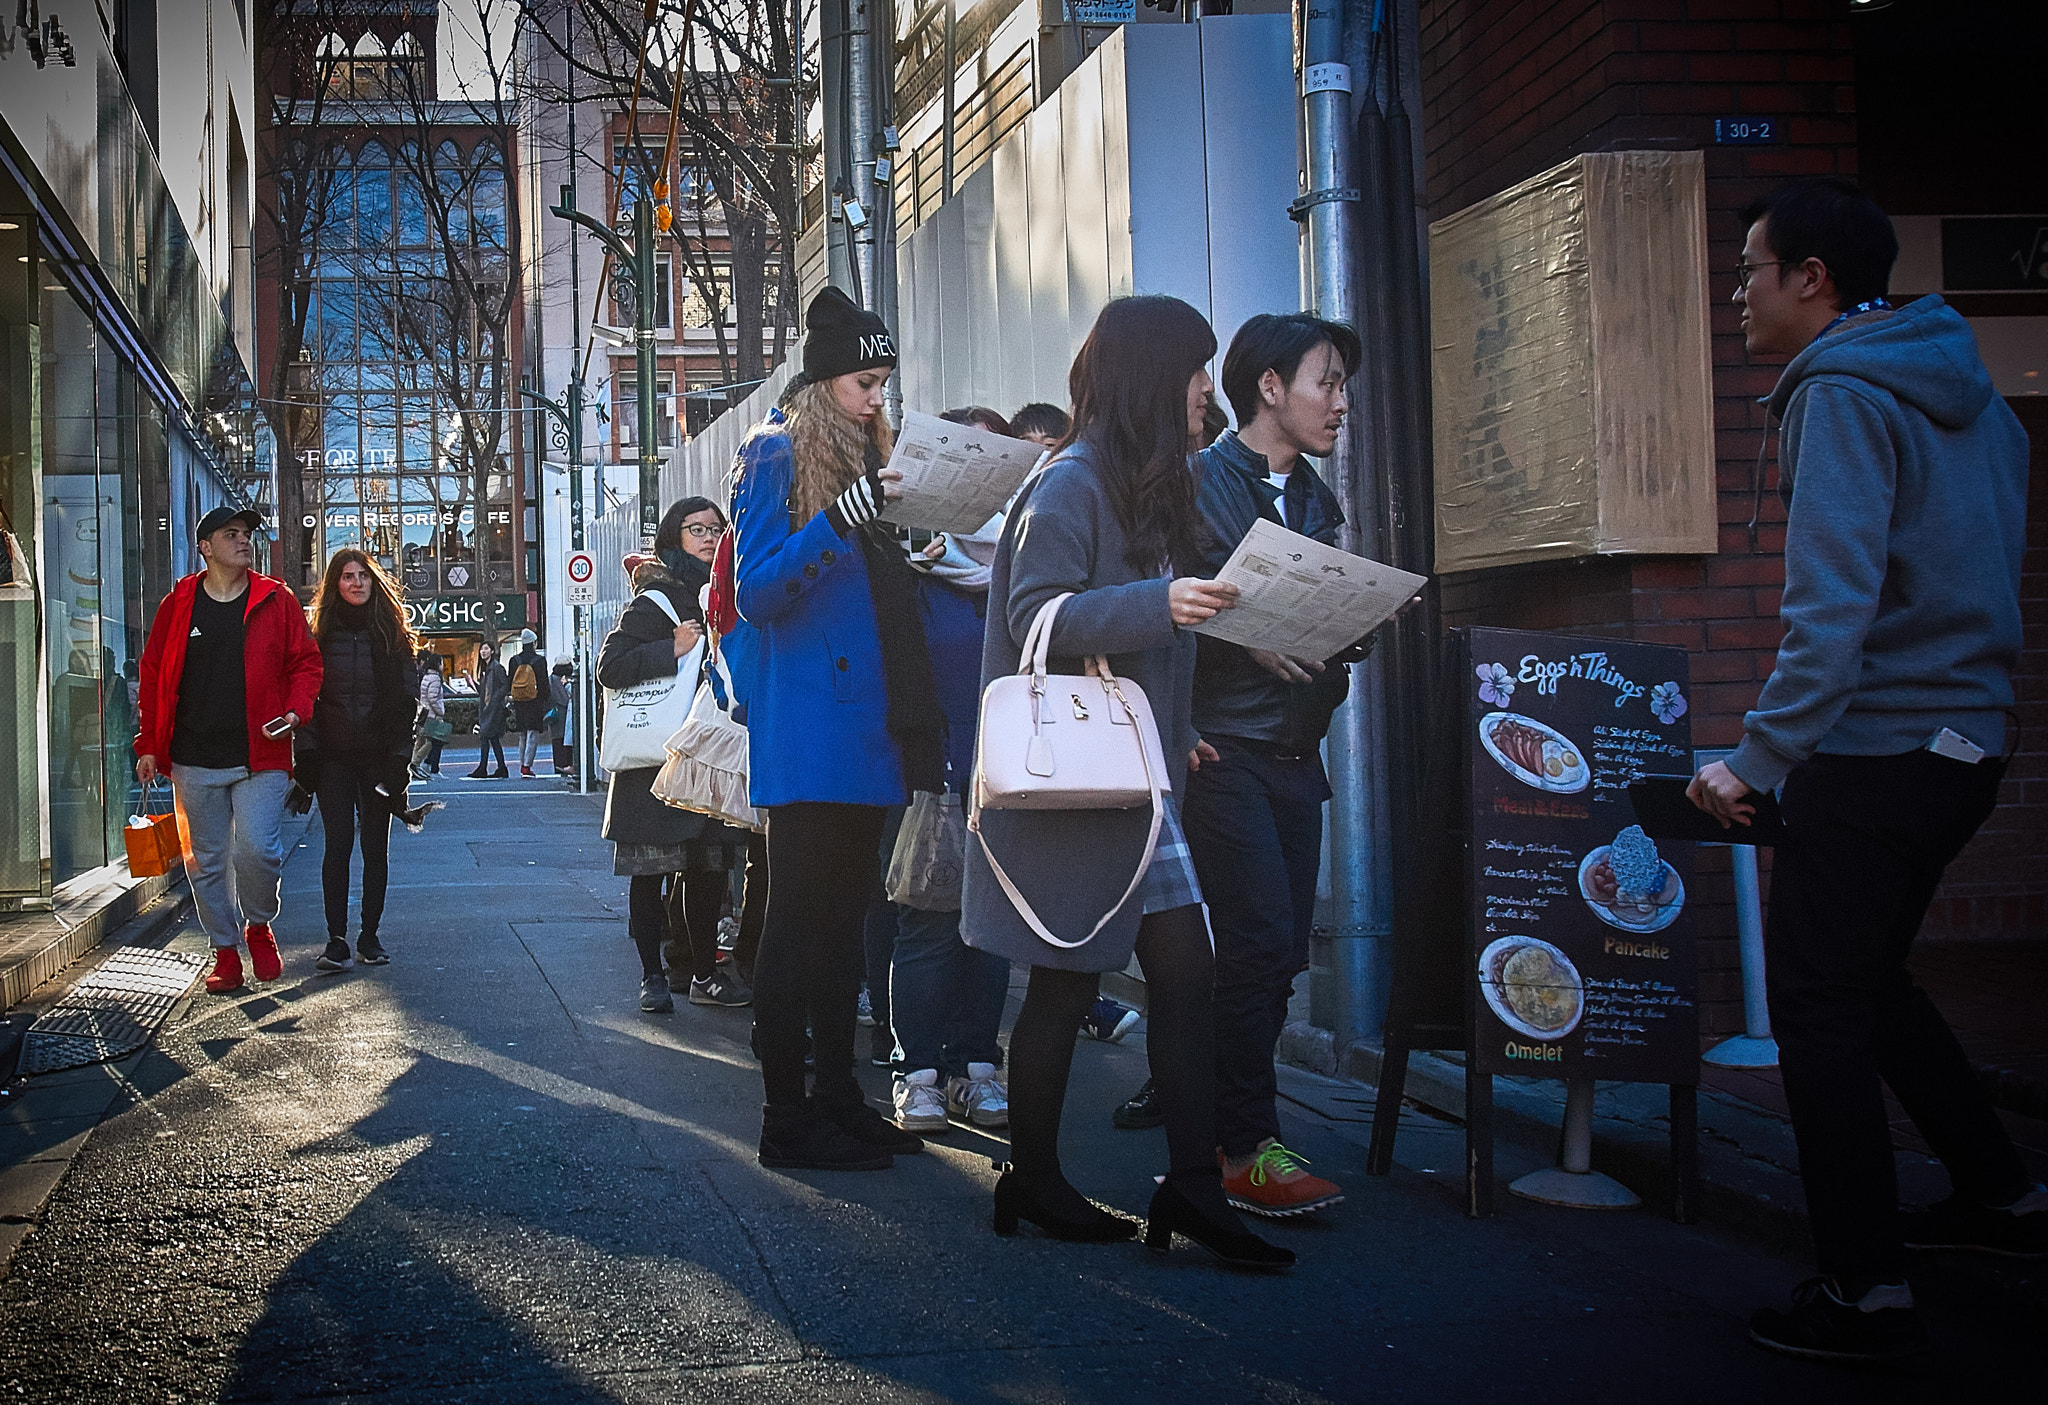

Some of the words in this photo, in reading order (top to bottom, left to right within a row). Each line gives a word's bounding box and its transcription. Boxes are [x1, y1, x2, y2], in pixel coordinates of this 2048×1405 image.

[1730, 122, 1770, 138] 30-2
[302, 513, 359, 528] OWER
[363, 511, 455, 527] RECORDS
[460, 510, 511, 525] CFE
[574, 562, 588, 575] 30
[1518, 654, 1568, 696] Eggs
[1579, 652, 1646, 708] Things
[1604, 936, 1671, 960] Pancake
[1505, 1040, 1564, 1062] Omelet
